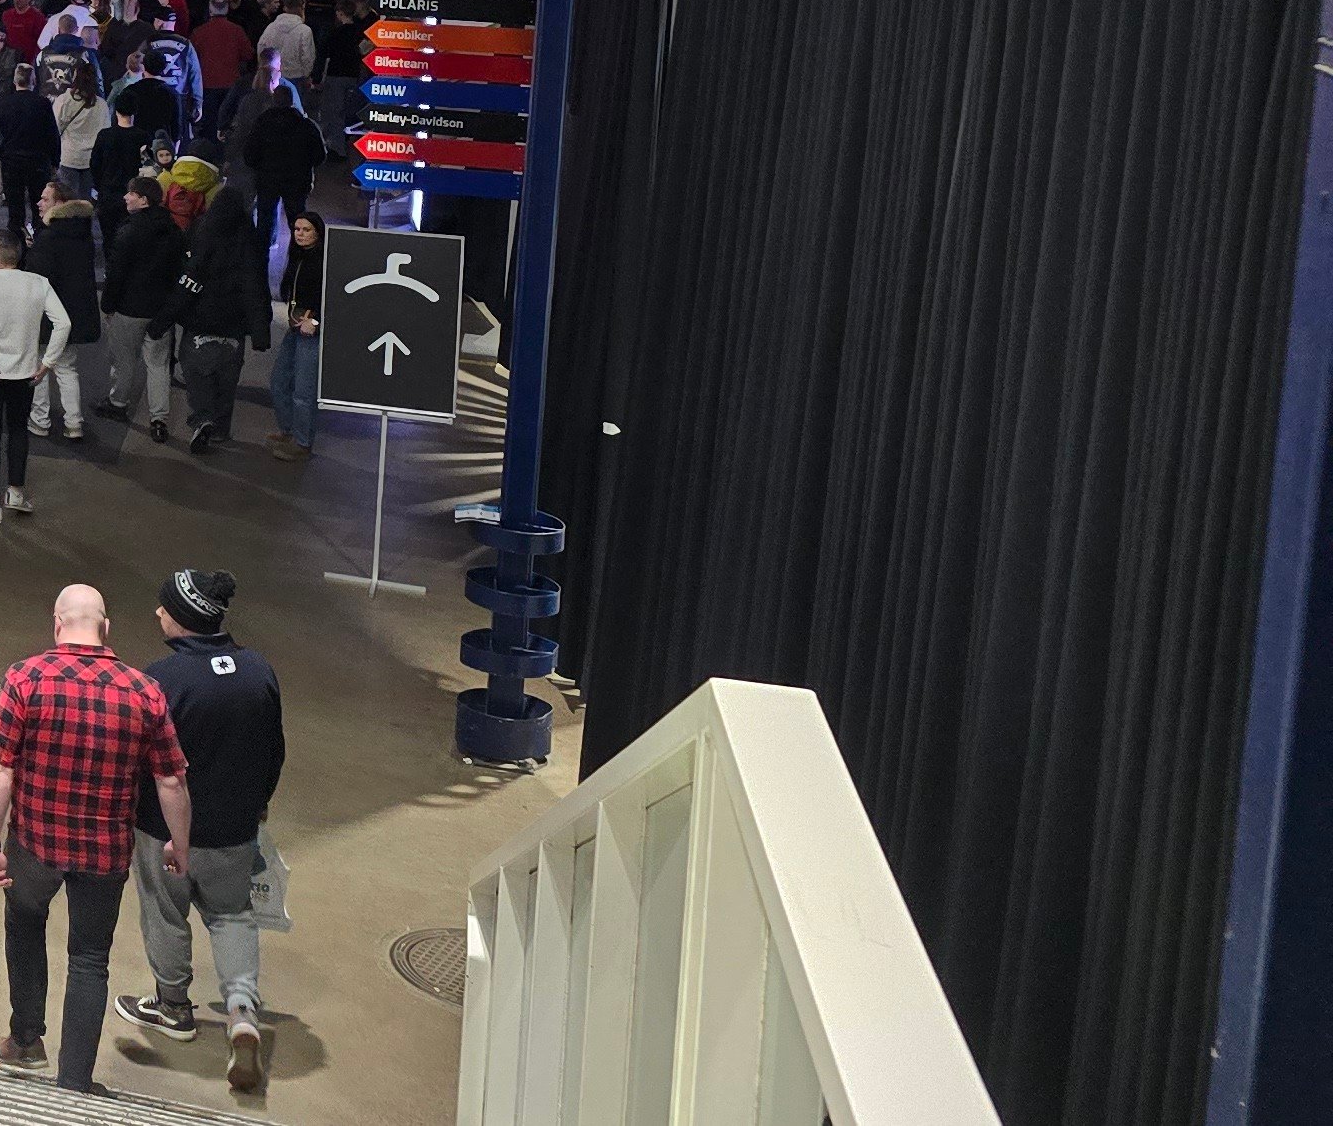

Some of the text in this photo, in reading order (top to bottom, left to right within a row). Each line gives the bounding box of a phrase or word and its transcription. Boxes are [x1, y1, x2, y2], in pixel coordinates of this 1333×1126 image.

[377, 28, 434, 41] Eurobiker
[374, 55, 429, 70] Biketeam
[371, 84, 406, 96] BMW
[369, 110, 464, 128] Harley-Davidson
[367, 140, 416, 154] HONDA
[364, 168, 414, 183] SUZUKI
